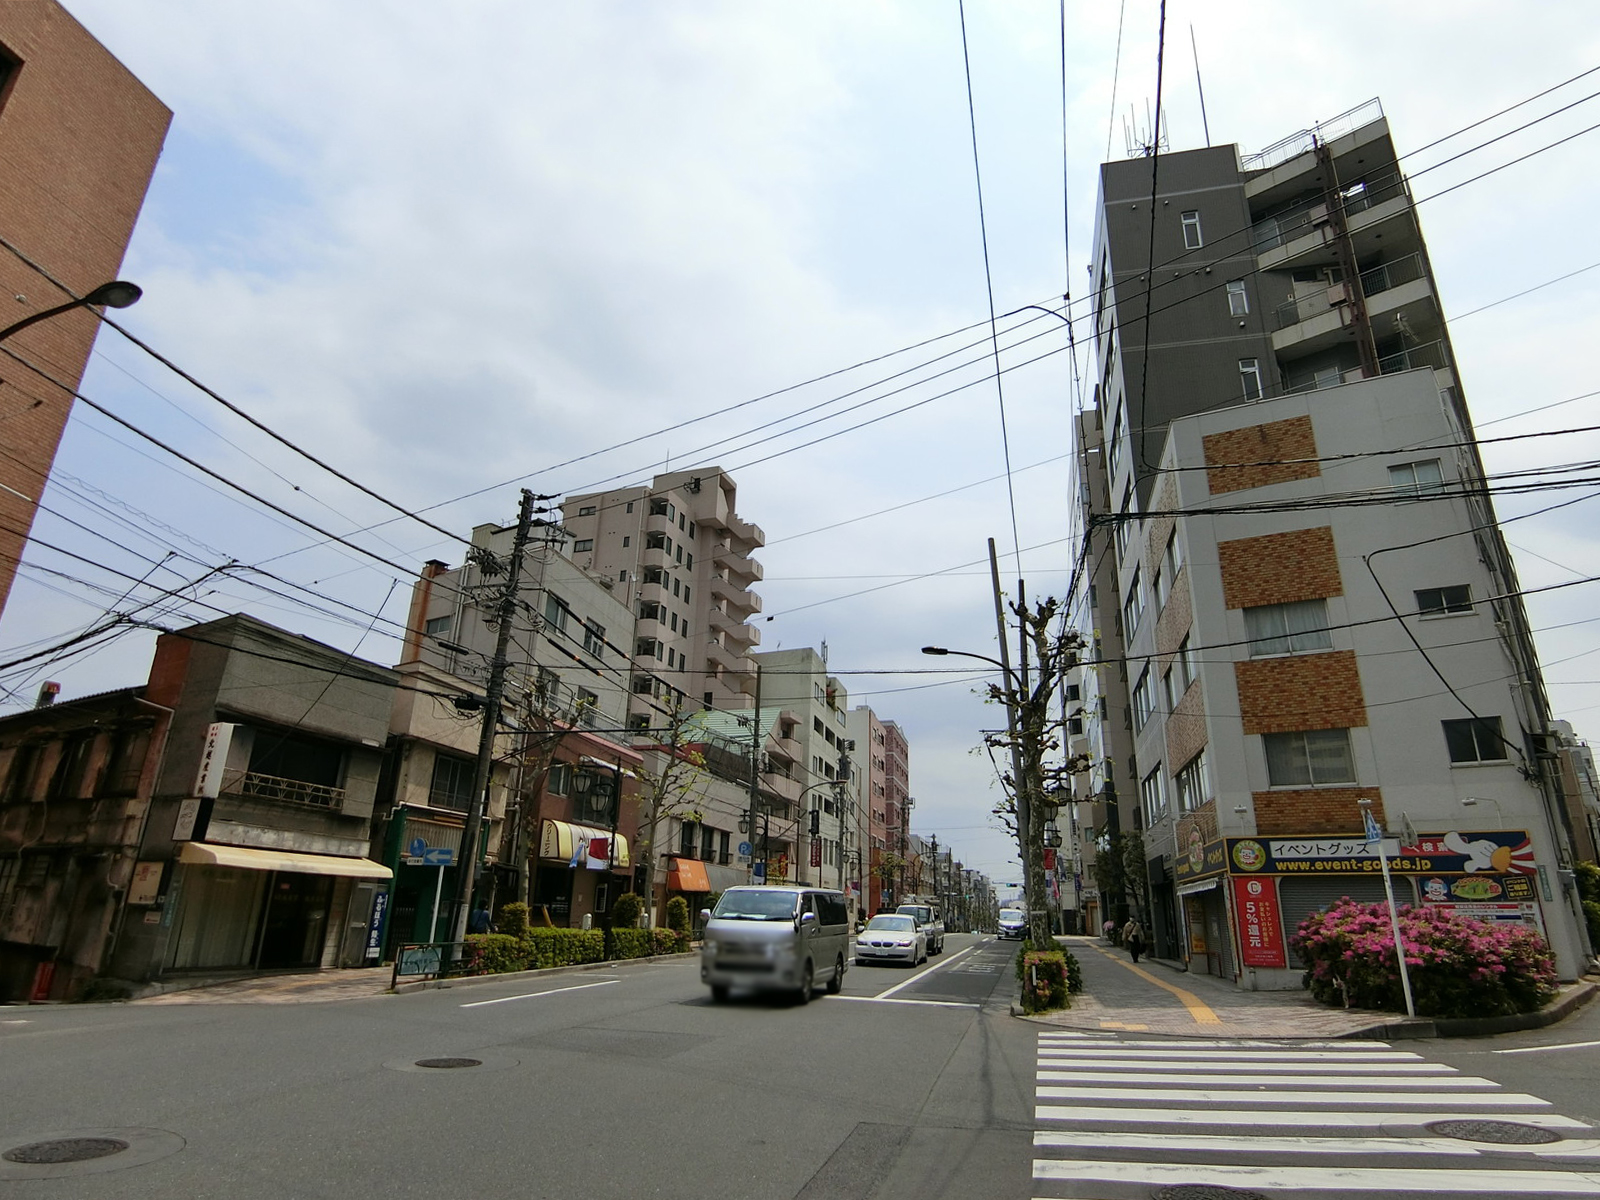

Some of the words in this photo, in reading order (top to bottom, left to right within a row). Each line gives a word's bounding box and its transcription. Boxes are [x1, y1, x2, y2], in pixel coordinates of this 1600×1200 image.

[543, 823, 553, 857] クリーニング
[1274, 842, 1369, 856] イベントグッズ
[1245, 901, 1261, 947] 5%還元
